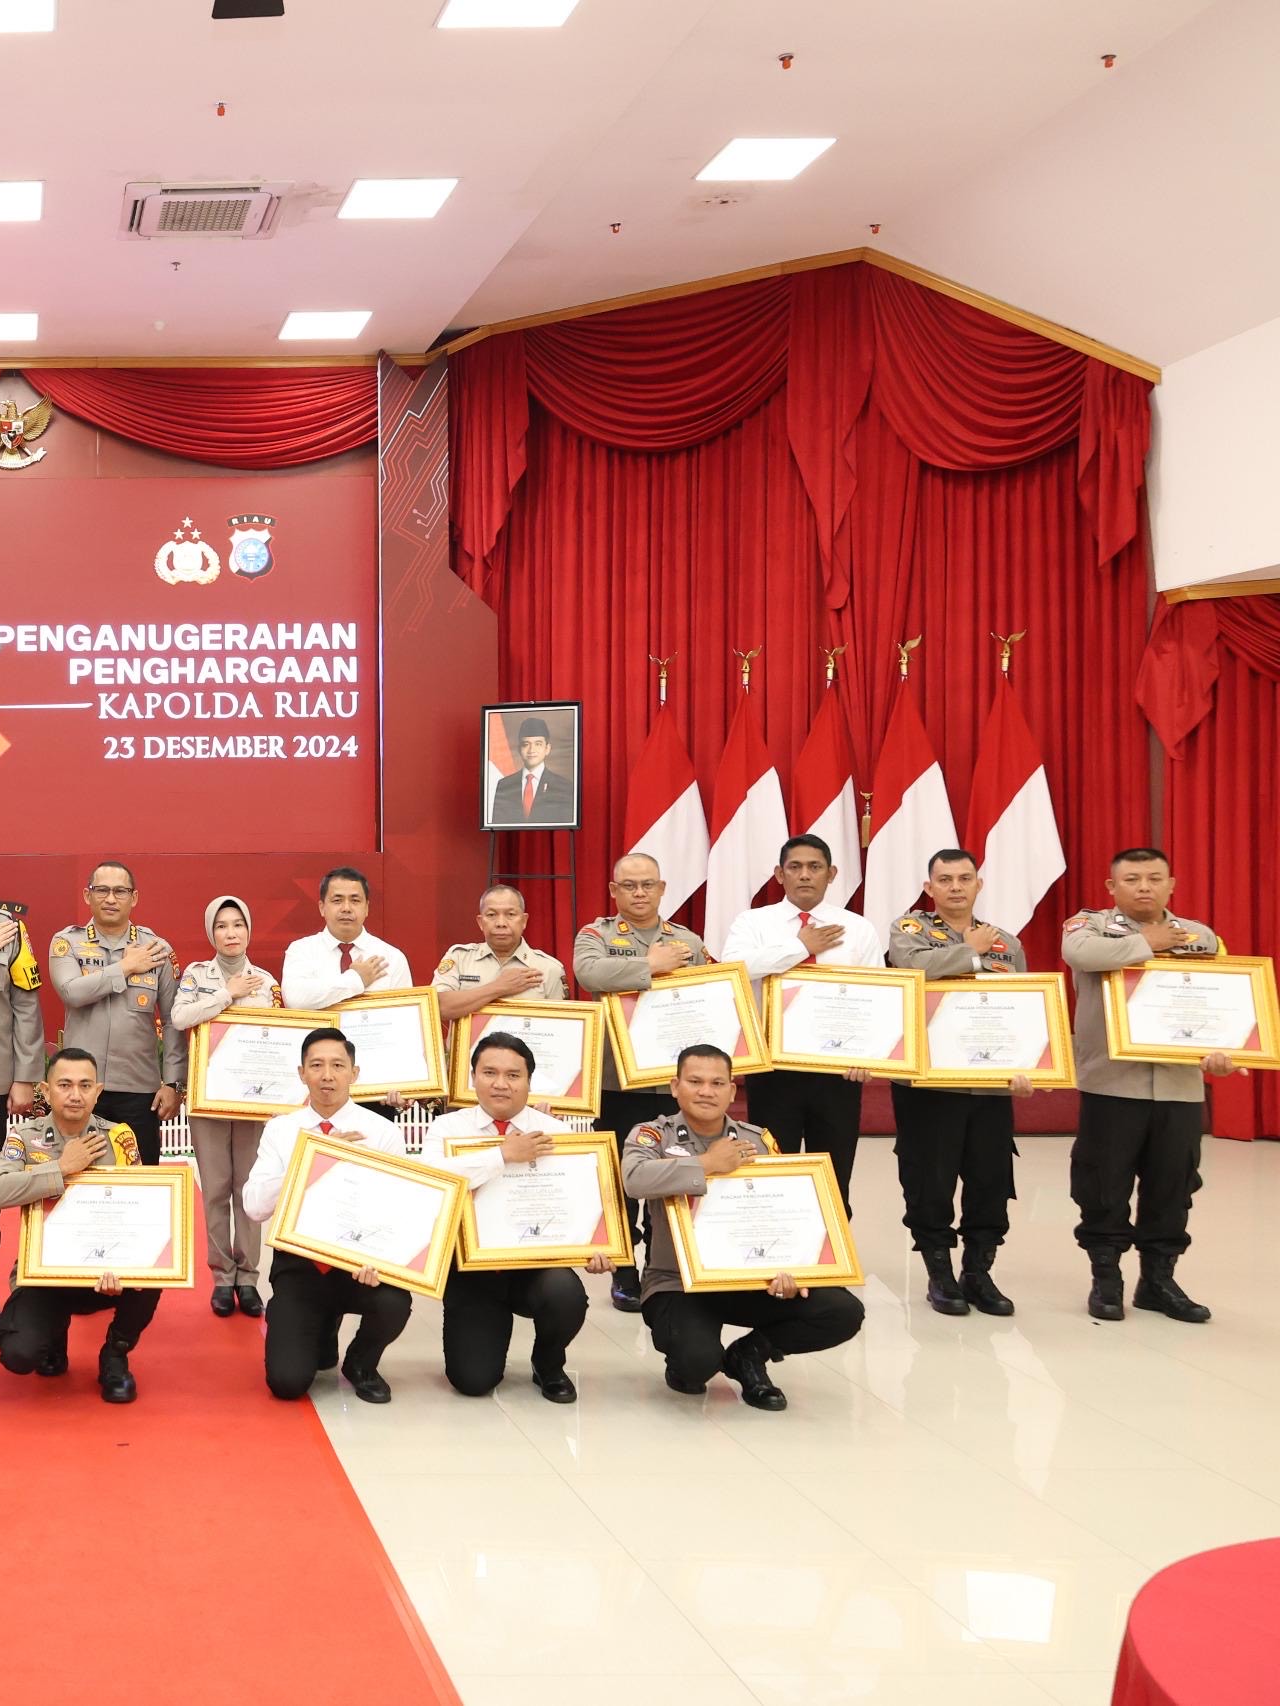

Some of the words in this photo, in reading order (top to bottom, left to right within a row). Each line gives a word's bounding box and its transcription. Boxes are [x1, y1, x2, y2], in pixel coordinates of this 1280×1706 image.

[231, 516, 272, 525] RIAU
[69, 656, 358, 685] PENGHARGAAN
[98, 692, 264, 720] KAPOLDA
[274, 692, 360, 719] RIAU
[103, 736, 136, 760] 23
[143, 735, 288, 760] DESEMBER
[292, 735, 359, 759] 2024
[609, 948, 637, 957] BUDI
[78, 958, 104, 967] DENI
